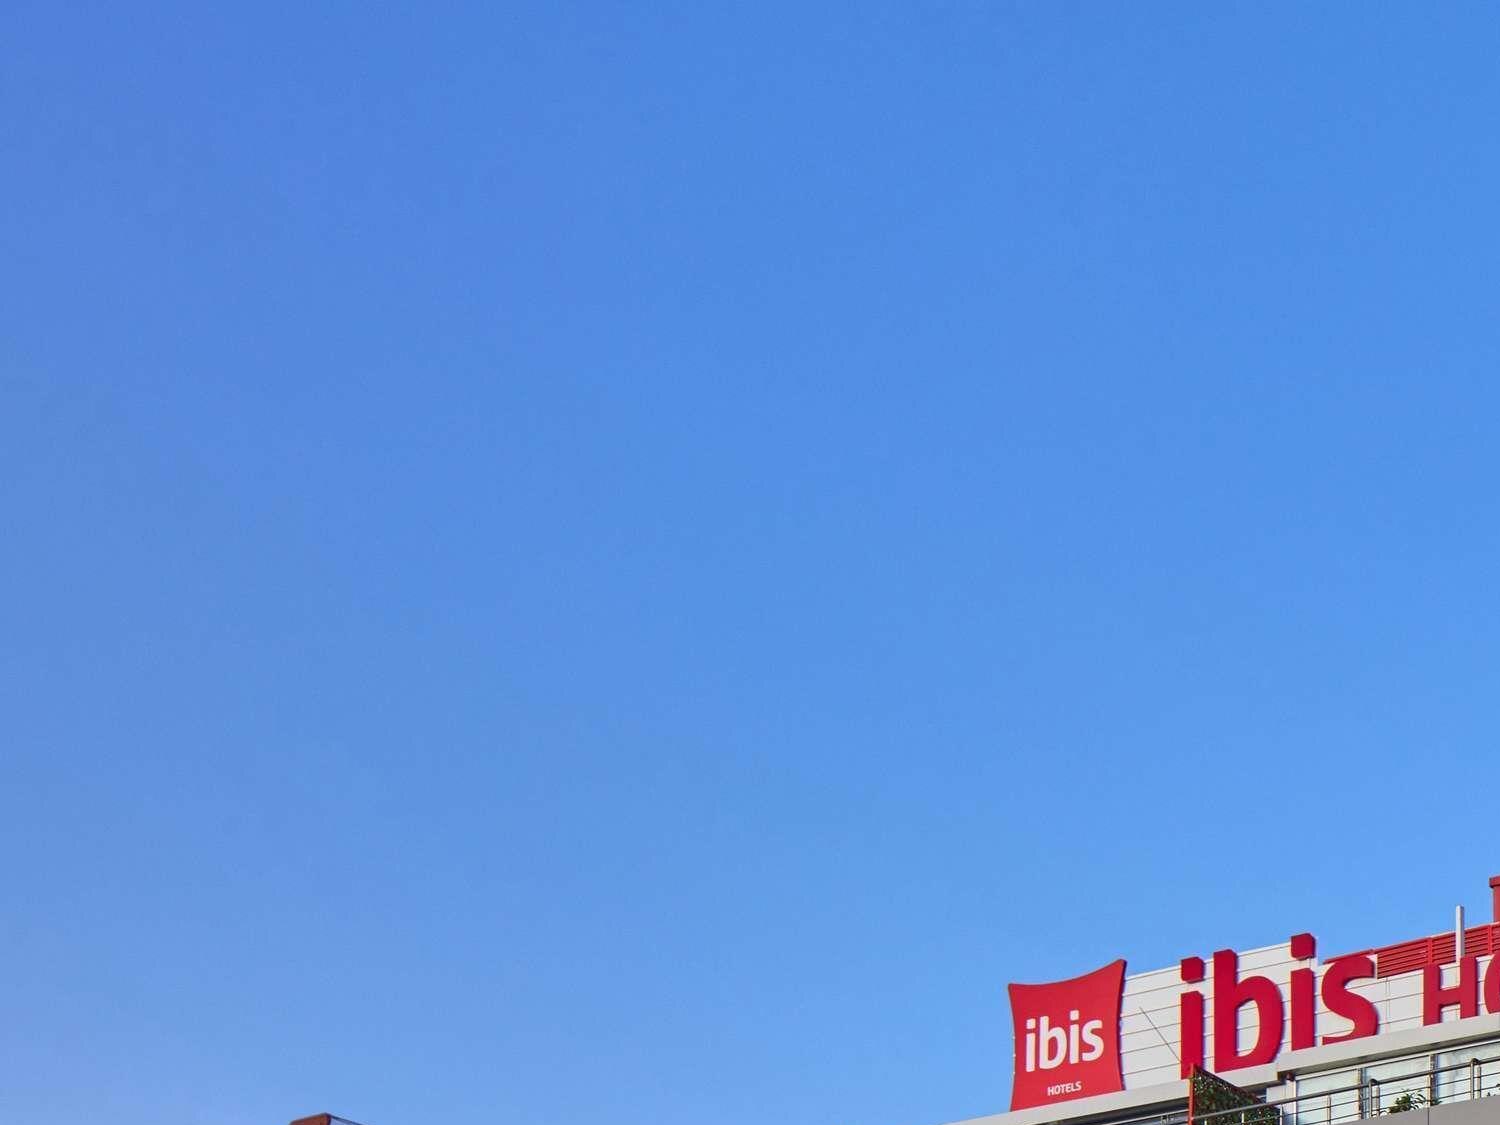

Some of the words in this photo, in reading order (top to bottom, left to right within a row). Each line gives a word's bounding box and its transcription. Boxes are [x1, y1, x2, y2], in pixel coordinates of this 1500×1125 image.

[1180, 932, 1380, 1080] ibis
[1025, 1009, 1105, 1072] ibis
[1047, 1081, 1082, 1096] HOTELS
